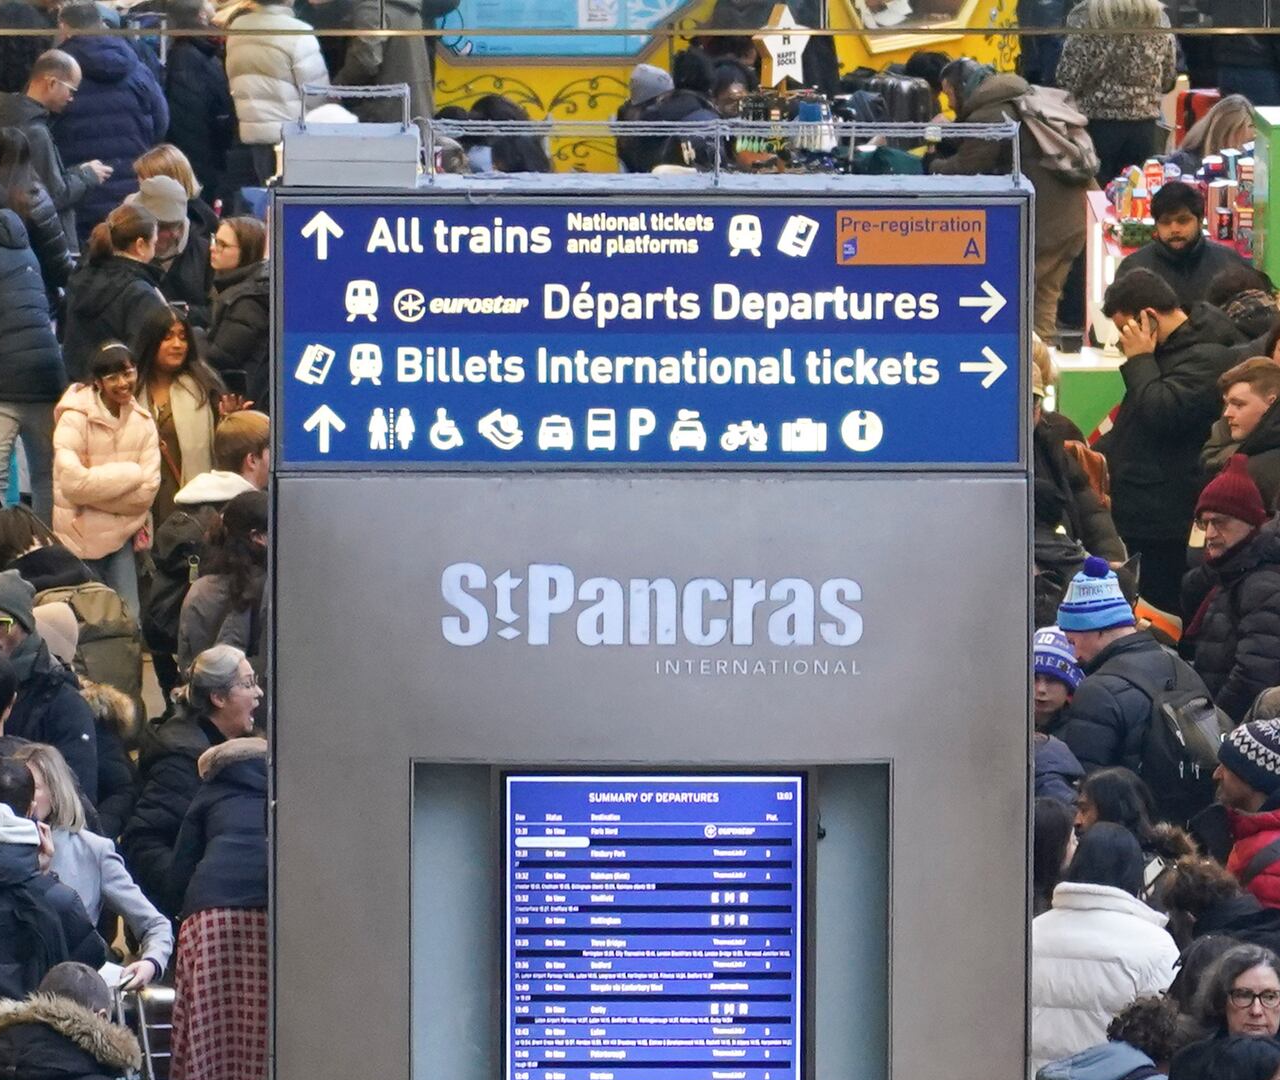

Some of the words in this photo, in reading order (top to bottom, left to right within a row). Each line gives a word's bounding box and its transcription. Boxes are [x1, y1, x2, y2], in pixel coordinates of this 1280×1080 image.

[568, 213, 645, 231] National
[651, 213, 714, 231] tickets
[841, 215, 982, 236] Pre-registration
[367, 217, 423, 253] All
[434, 218, 551, 253] trains
[567, 235, 601, 253] and
[607, 235, 698, 257] platforms
[963, 236, 981, 258] A
[430, 296, 529, 313] eurostar
[544, 282, 700, 327] Départs
[714, 284, 939, 327] Departures
[397, 347, 525, 382] Billets
[538, 347, 795, 384] International
[806, 349, 939, 385] tickets
[1037, 633, 1055, 644] 10
[655, 659, 863, 676] INTERNATIONAL
[589, 792, 638, 803] SUMMARY
[640, 793, 653, 802] OF
[656, 792, 719, 803] DEPARTURES
